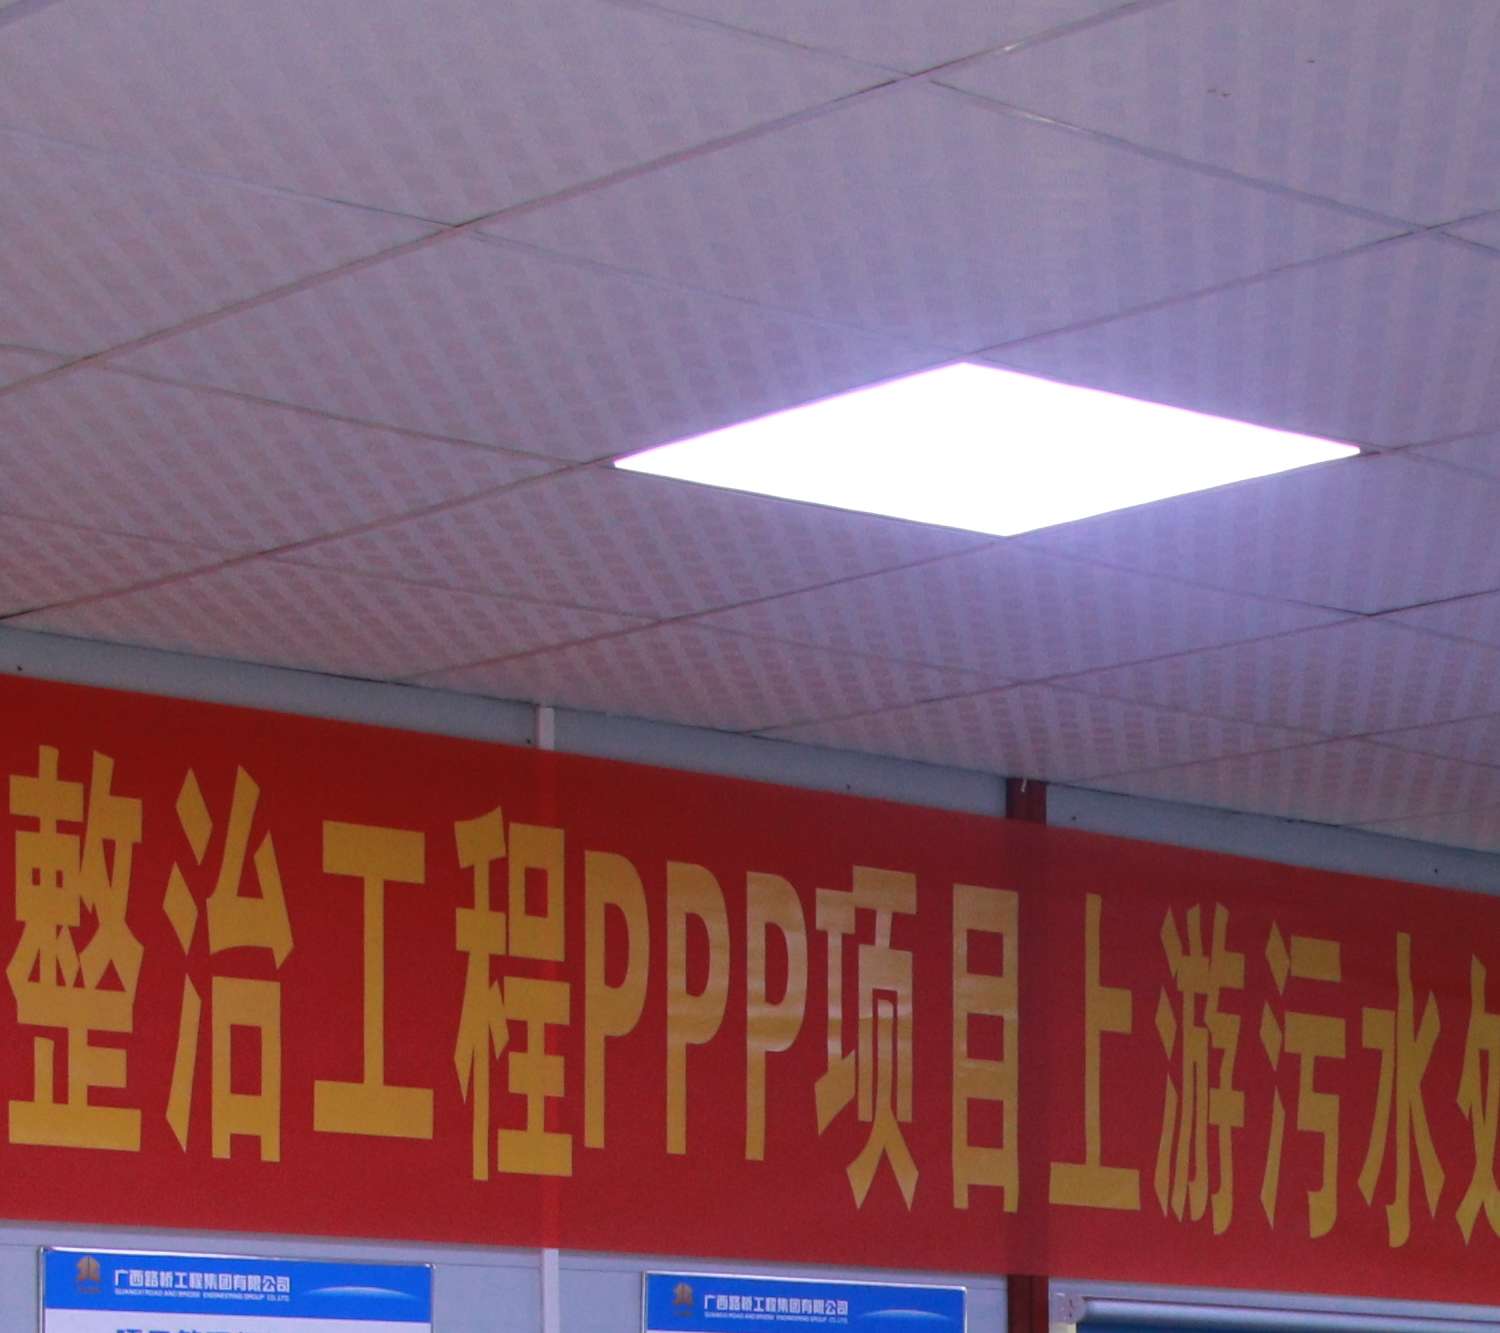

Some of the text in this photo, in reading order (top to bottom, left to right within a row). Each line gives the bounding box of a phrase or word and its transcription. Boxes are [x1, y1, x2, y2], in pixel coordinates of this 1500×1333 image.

[114, 1269, 291, 1293] 广西路桥工程集团有限公司
